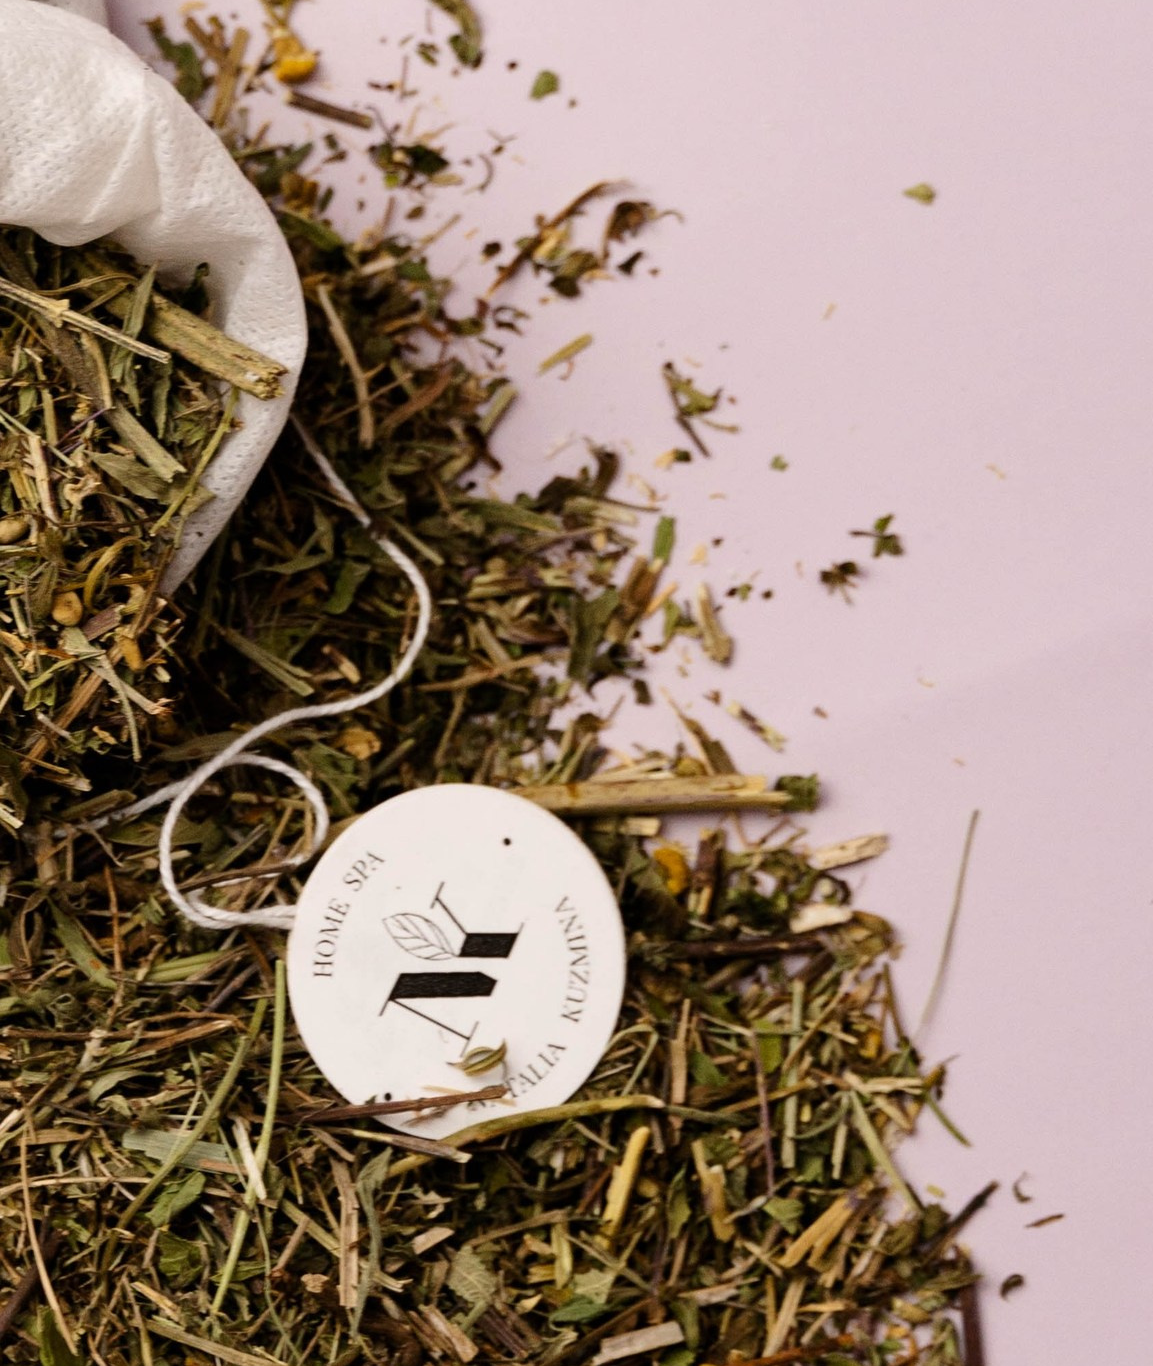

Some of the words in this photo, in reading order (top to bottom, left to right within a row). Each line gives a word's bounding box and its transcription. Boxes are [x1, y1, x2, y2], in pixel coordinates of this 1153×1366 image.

[313, 897, 351, 978] HOME
[342, 850, 386, 892] SPA
[466, 1043, 567, 1112] TALIA
[554, 896, 591, 1024] KUZMINA
